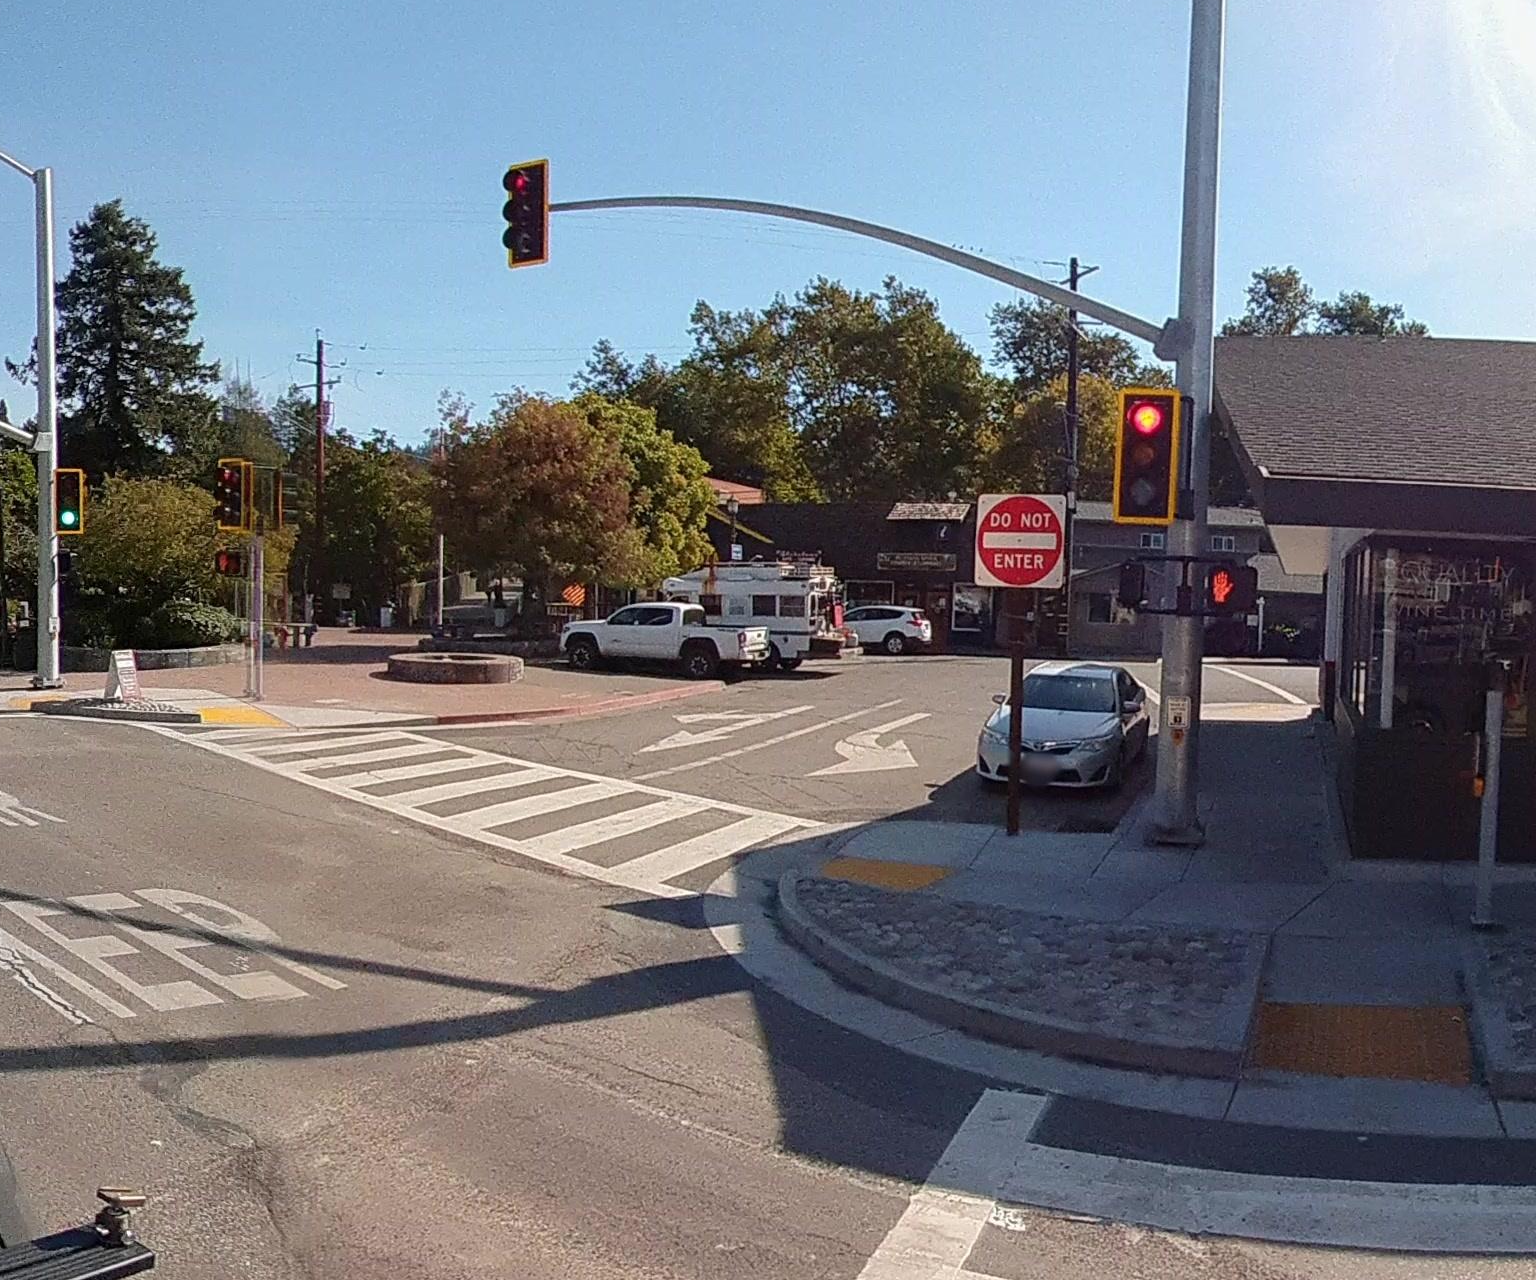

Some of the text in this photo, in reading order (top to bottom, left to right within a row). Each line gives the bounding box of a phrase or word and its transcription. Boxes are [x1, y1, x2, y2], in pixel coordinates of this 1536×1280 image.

[990, 512, 1052, 528] DO NOT
[993, 553, 1044, 569] ENTER
[1401, 560, 1515, 585] QUALITY
[1458, 605, 1515, 621] TIME
